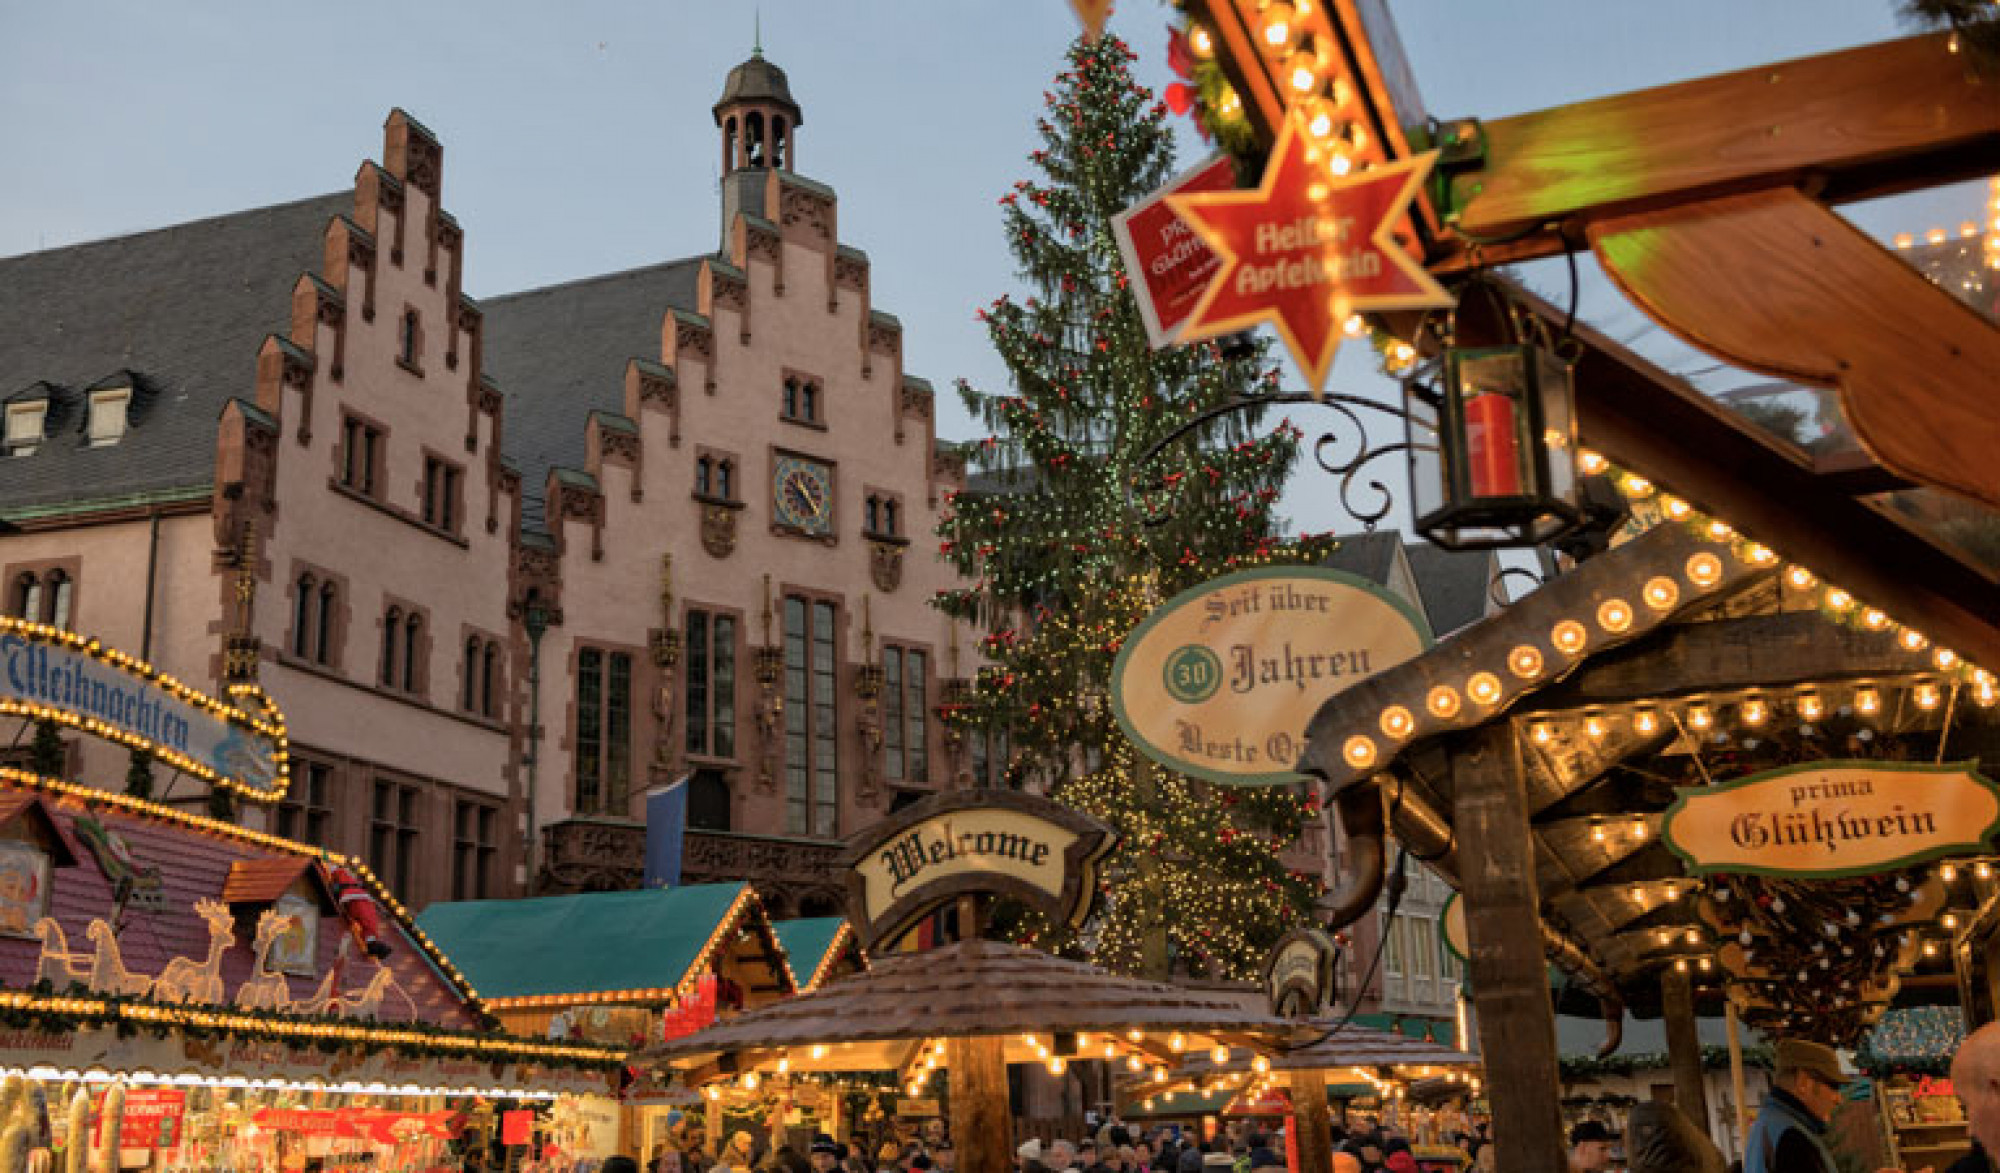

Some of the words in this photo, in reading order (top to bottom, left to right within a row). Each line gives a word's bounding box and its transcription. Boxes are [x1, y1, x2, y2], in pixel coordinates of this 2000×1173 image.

[1256, 216, 1356, 254] Heißr
[1203, 585, 1260, 624] Seit
[1269, 583, 1331, 612] über
[1177, 660, 1207, 687] 30
[1229, 641, 1371, 694] Jahren
[1, 635, 189, 750] Weihnachten
[1790, 778, 1875, 808] prima
[1731, 804, 1938, 853] Glühwein
[881, 818, 1050, 897] Welcome
